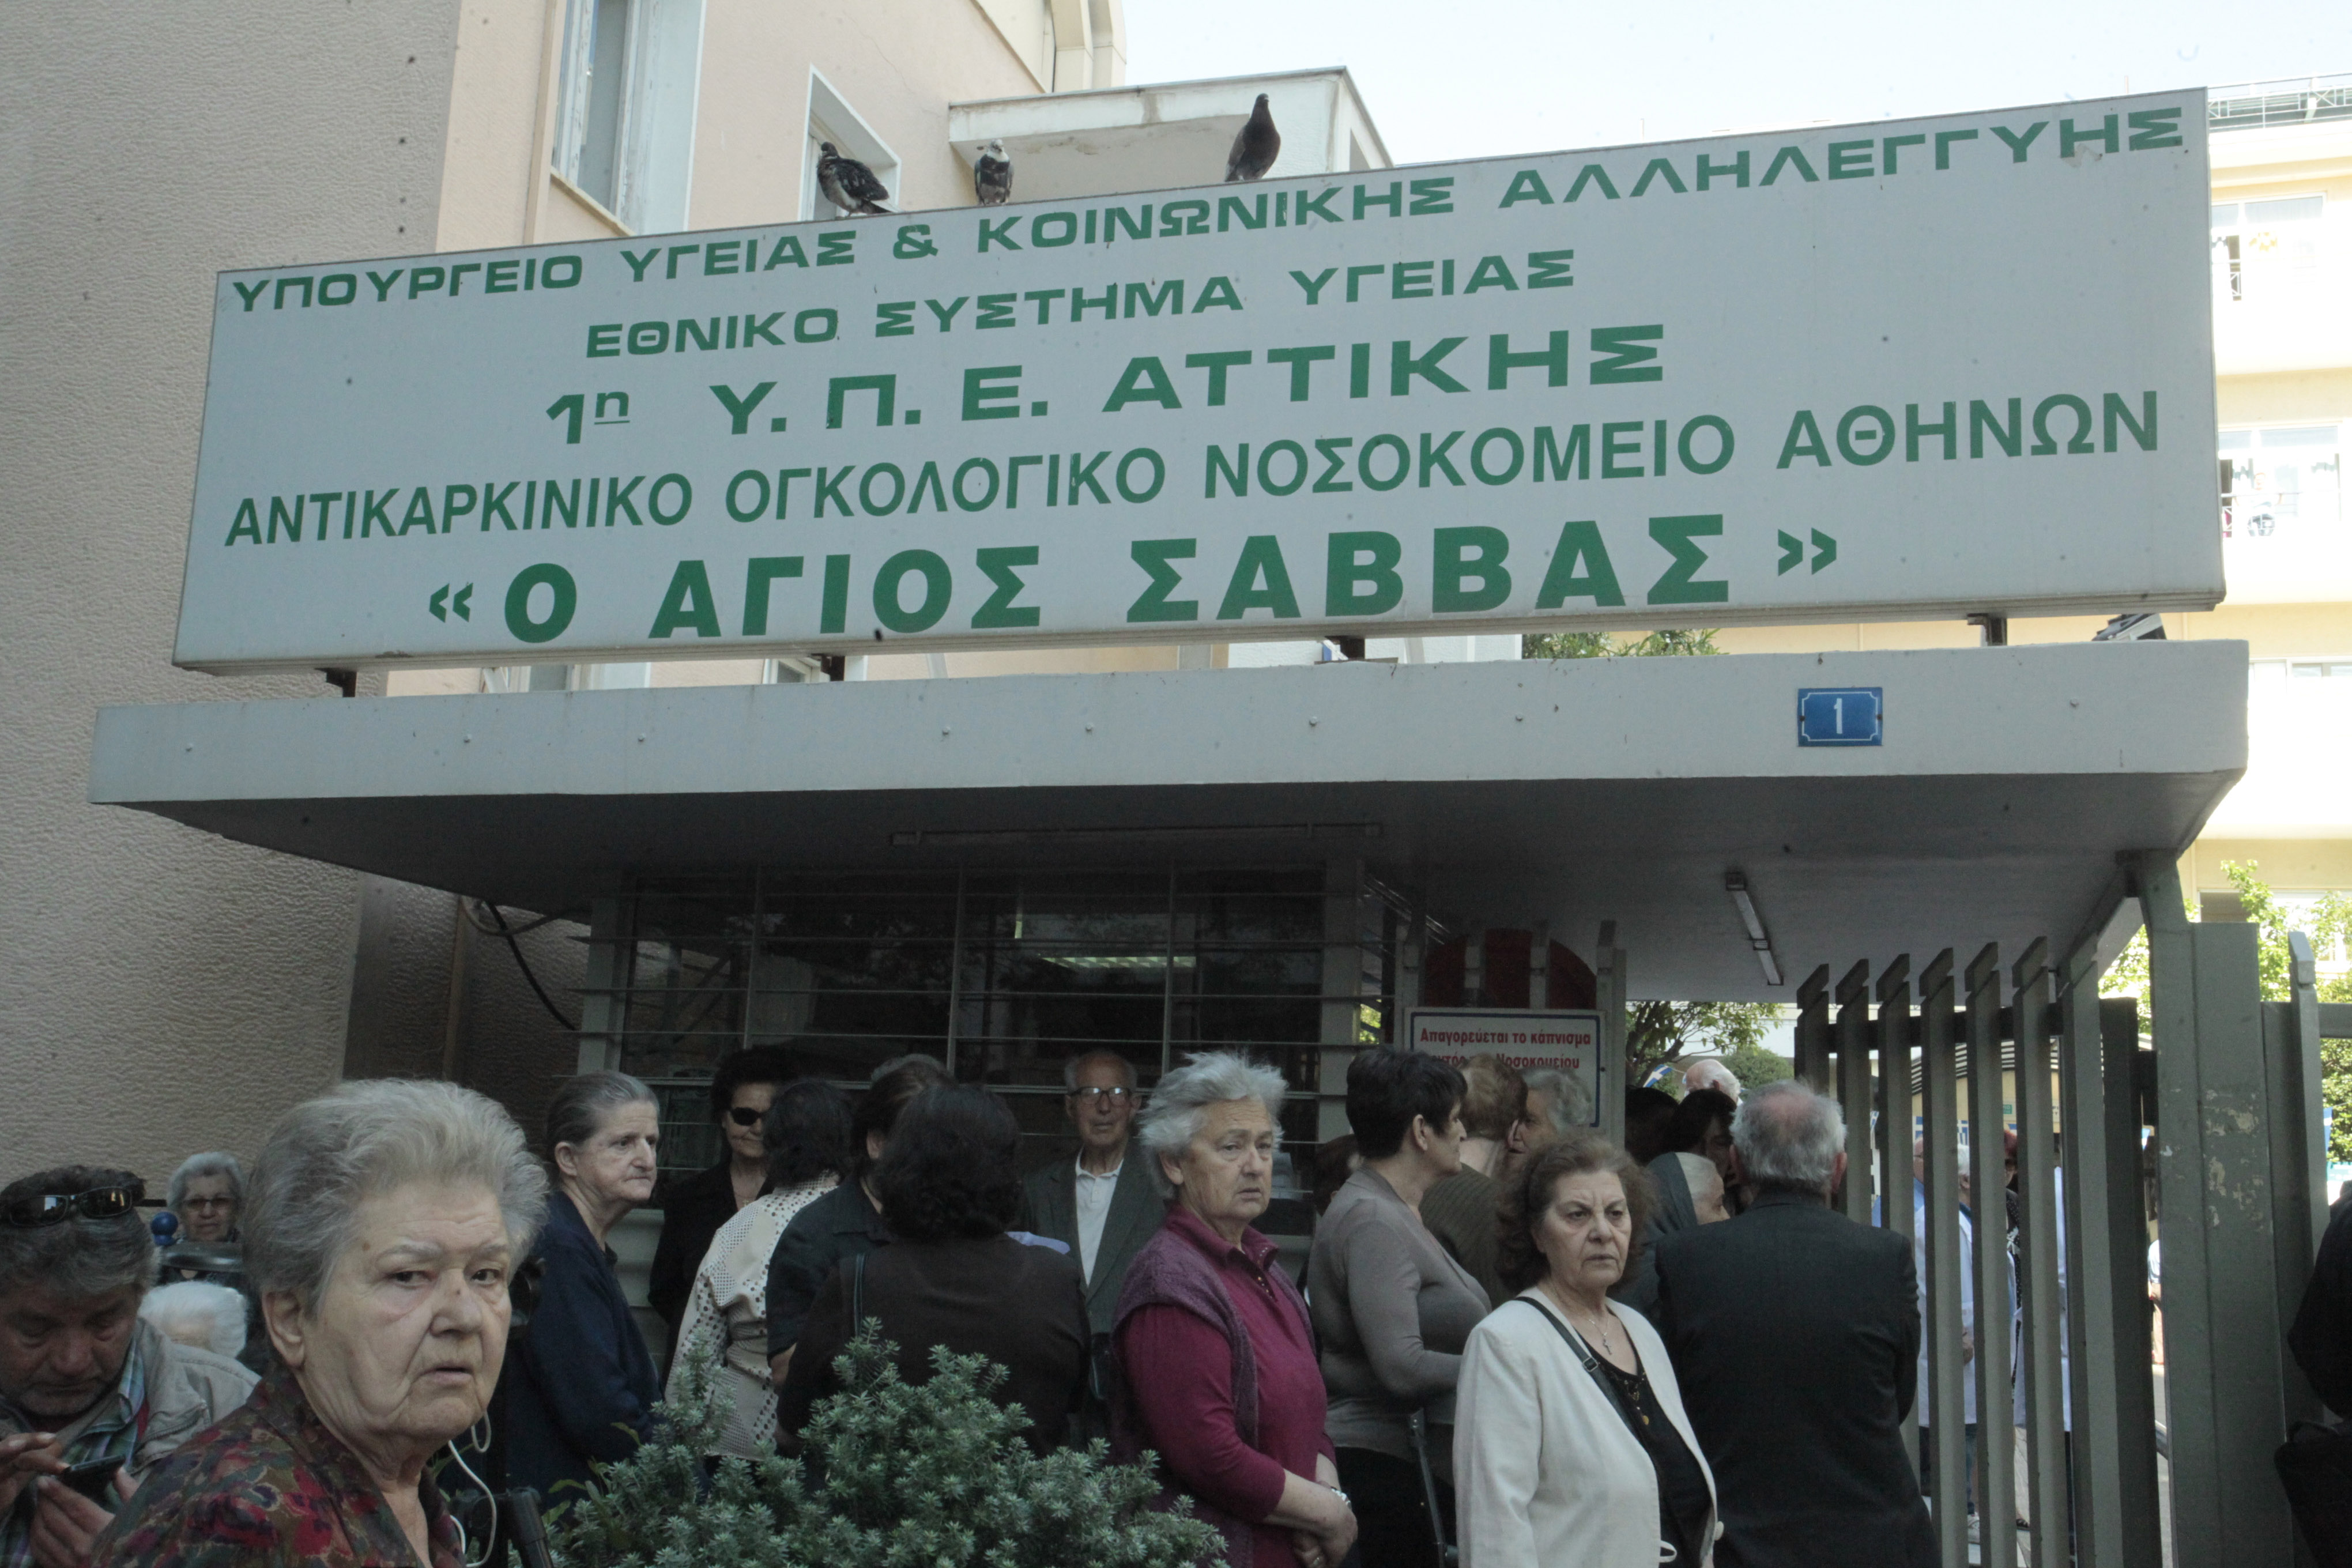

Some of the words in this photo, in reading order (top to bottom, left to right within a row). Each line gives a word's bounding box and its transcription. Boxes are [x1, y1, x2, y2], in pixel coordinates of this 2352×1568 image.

[232, 255, 583, 312] ΥΠΟΥΡΓΕΙΟ
[620, 230, 857, 282] ΥΓΕΙΑΣ
[892, 224, 938, 259] &
[978, 176, 1455, 253] ΚΟΙΝΩΝΙΚΗΣ
[1498, 107, 2184, 209] ΑΛΛΗΛΕΓΓΥΗΣ
[586, 308, 838, 359] ΕΘΝΙΚΟ
[875, 276, 1243, 338] ΣΥΣΤΗΜΑ
[1289, 248, 1574, 306] ΥΓΕΙΑΣ
[1102, 324, 1664, 412] ΑΤΤΙΚΗΣ
[224, 473, 693, 546] ΑΝΤΙΚΑΡΚΙΝΙΚΟ
[726, 447, 1166, 523] ΟΓΚΟΛΟΓΙΚΟ
[1205, 414, 1735, 499] ΝΟΣΟΚΟΜΕΙΟ
[1776, 391, 2159, 470] ΑΘΗΝΩΝ
[649, 545, 1041, 639] ΑΓΙΟΣ
[1833, 698, 1843, 734] 1
[1420, 1028, 1509, 1046] Απαγορεύεται
[1512, 1032, 1526, 1043] το
[1530, 1029, 1591, 1048] κάπνισμα
